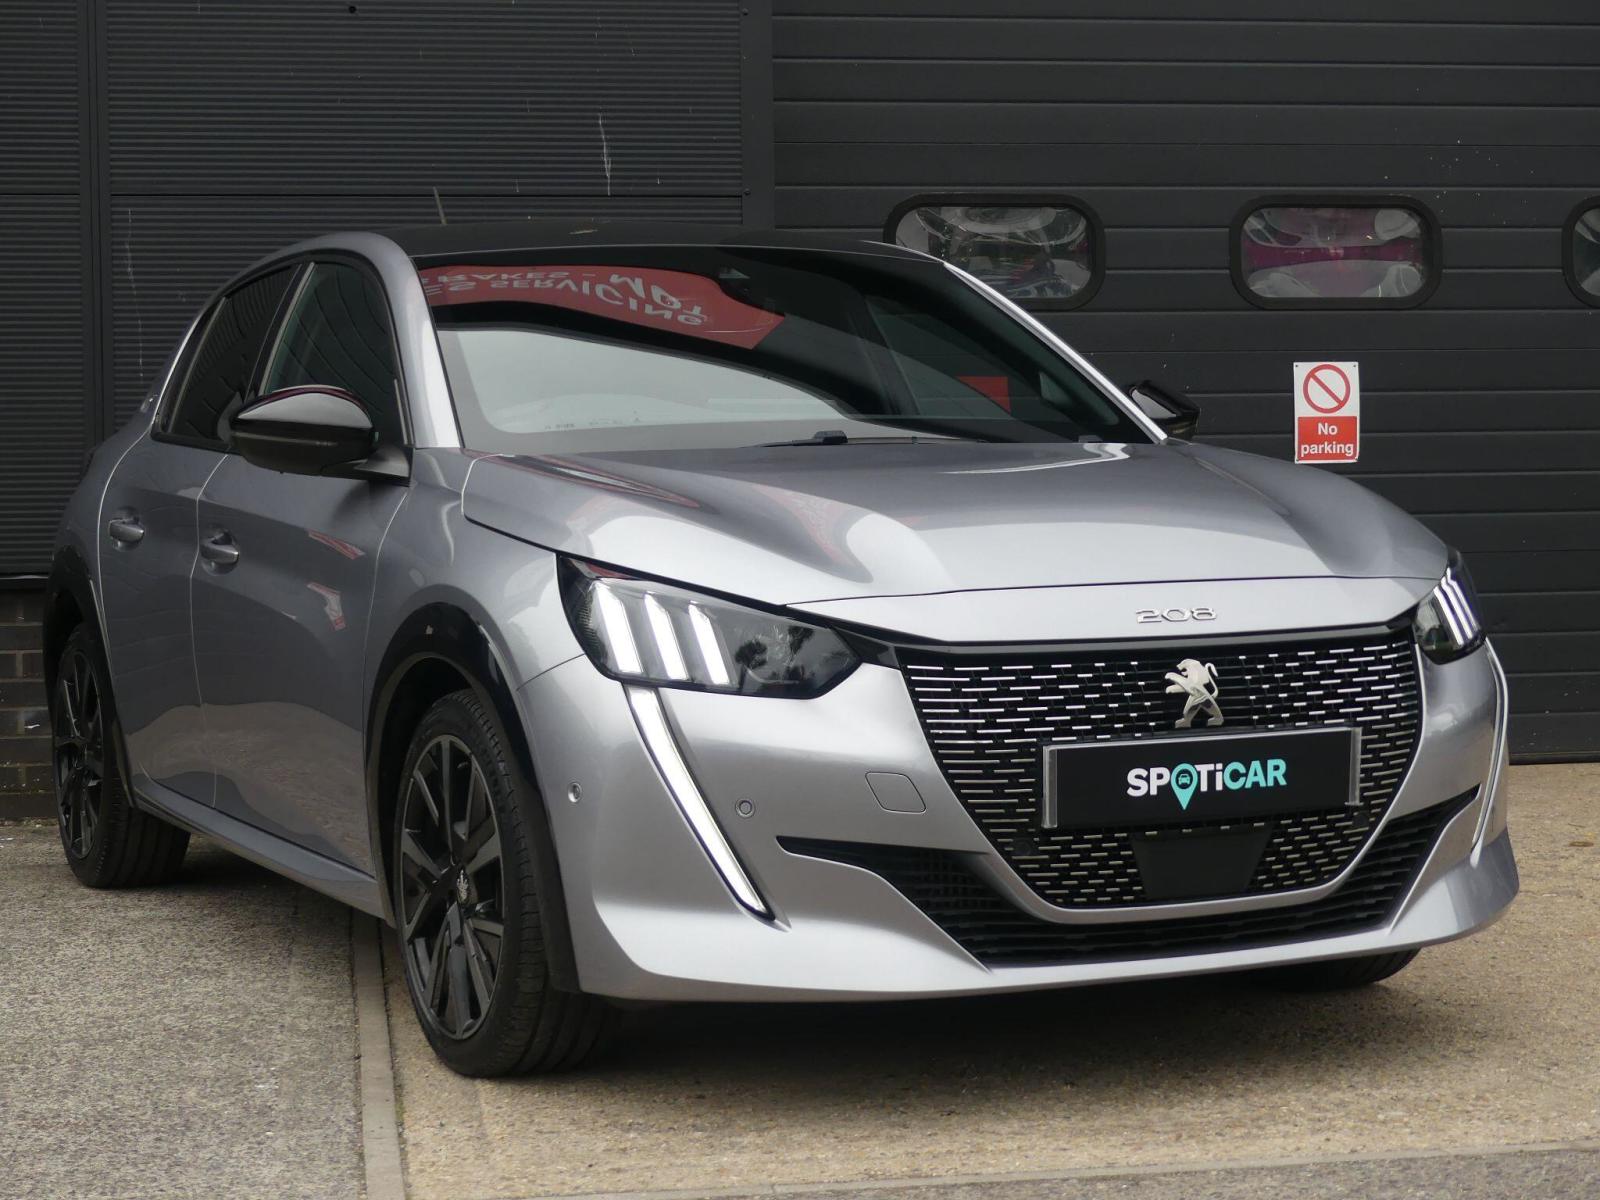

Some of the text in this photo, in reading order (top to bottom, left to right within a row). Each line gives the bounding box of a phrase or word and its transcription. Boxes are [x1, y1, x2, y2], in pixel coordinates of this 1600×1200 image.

[1317, 422, 1338, 435] No
[1300, 441, 1354, 457] parking
[1136, 607, 1217, 623] 208
